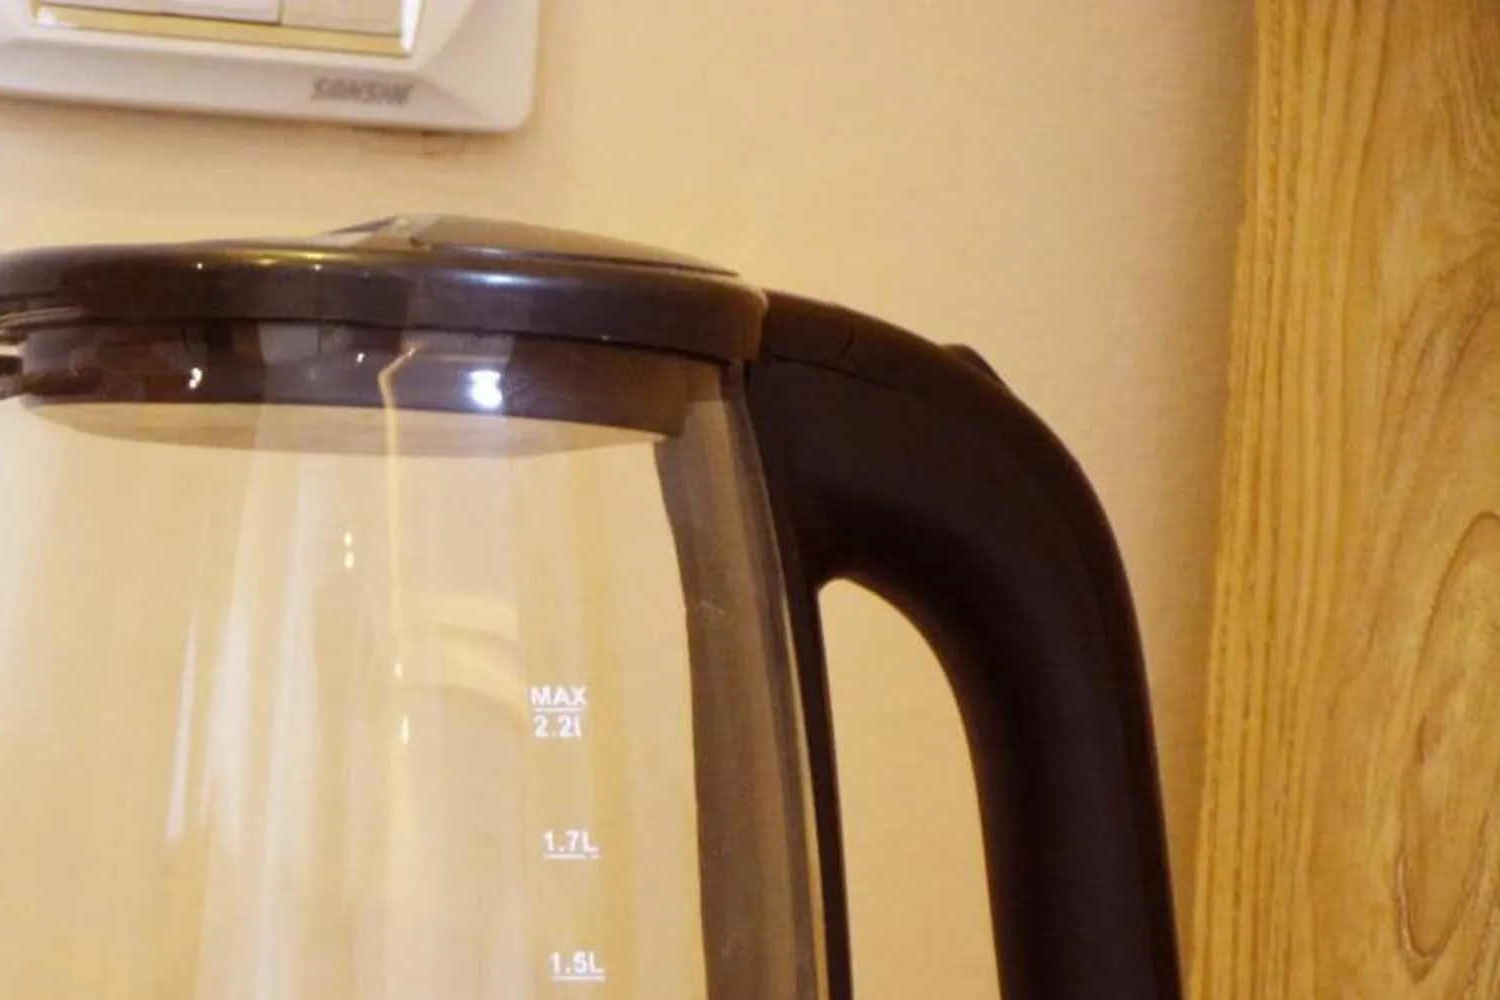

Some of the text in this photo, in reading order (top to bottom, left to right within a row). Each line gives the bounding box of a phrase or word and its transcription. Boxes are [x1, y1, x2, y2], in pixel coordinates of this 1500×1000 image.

[531, 685, 589, 706] MAX
[543, 829, 600, 853] 1.7L
[549, 951, 605, 975] 1.5L
